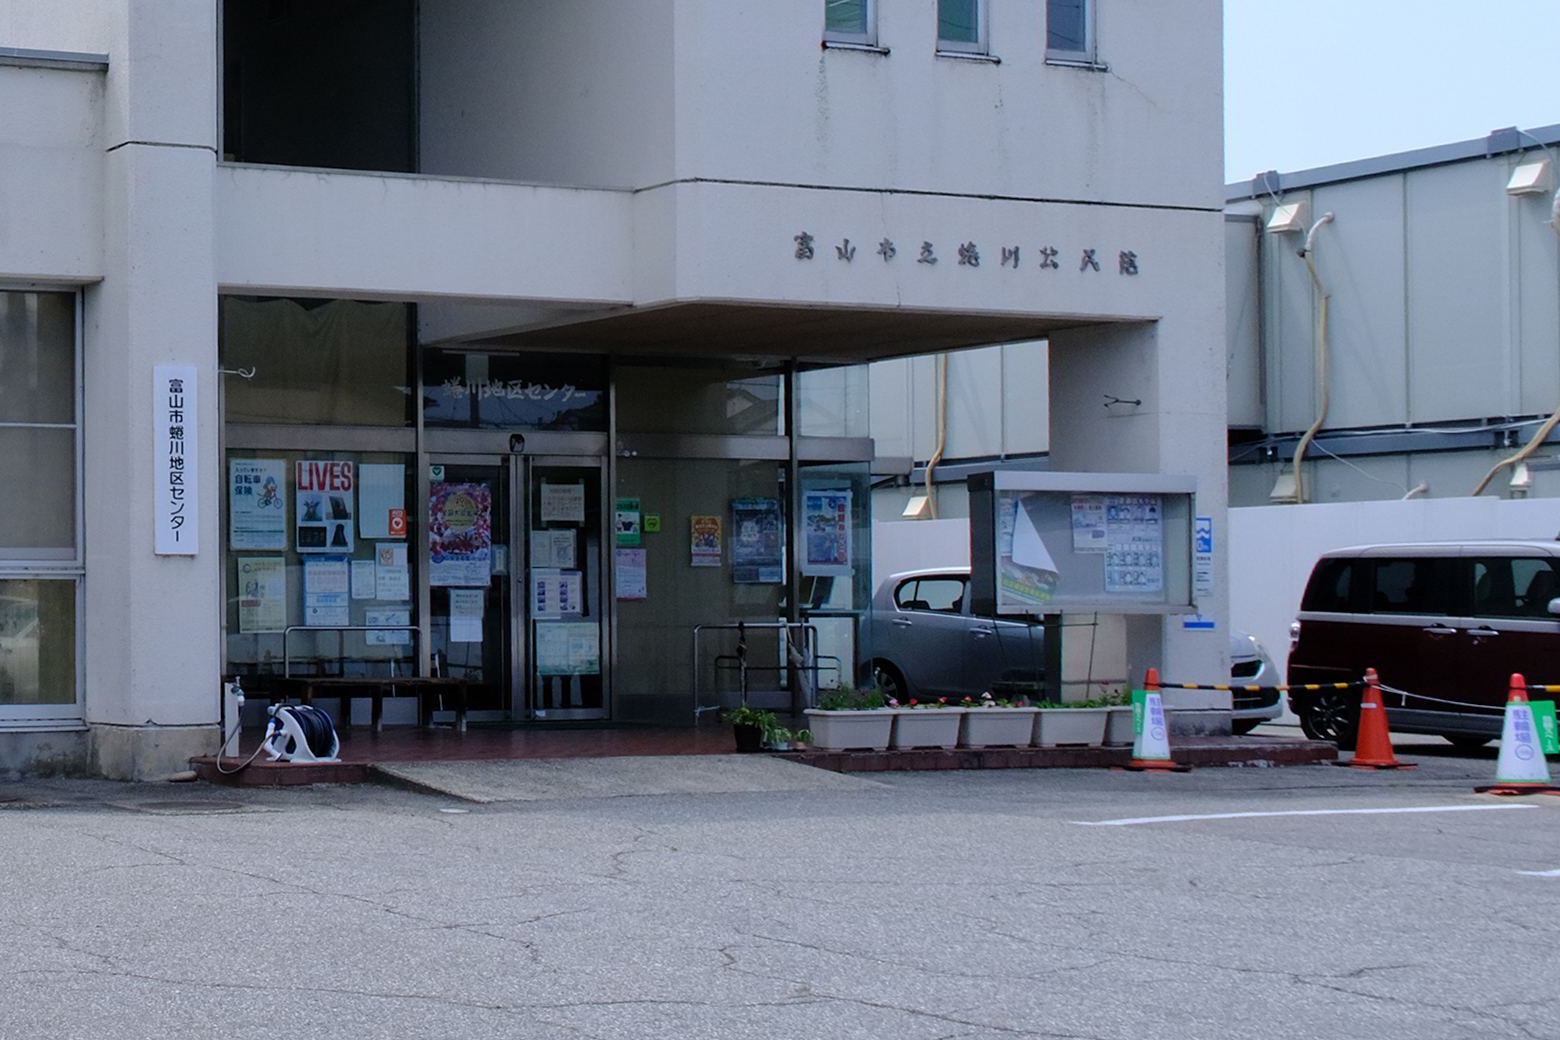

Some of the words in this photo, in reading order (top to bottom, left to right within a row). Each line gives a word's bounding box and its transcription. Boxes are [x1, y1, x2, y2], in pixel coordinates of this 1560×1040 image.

[441, 375, 587, 402] 蜷川地区センター
[168, 378, 185, 543] 富山市蜷川地区センター
[234, 474, 261, 484] 自転車
[234, 485, 253, 496] 保険
[297, 462, 352, 492] LIVES
